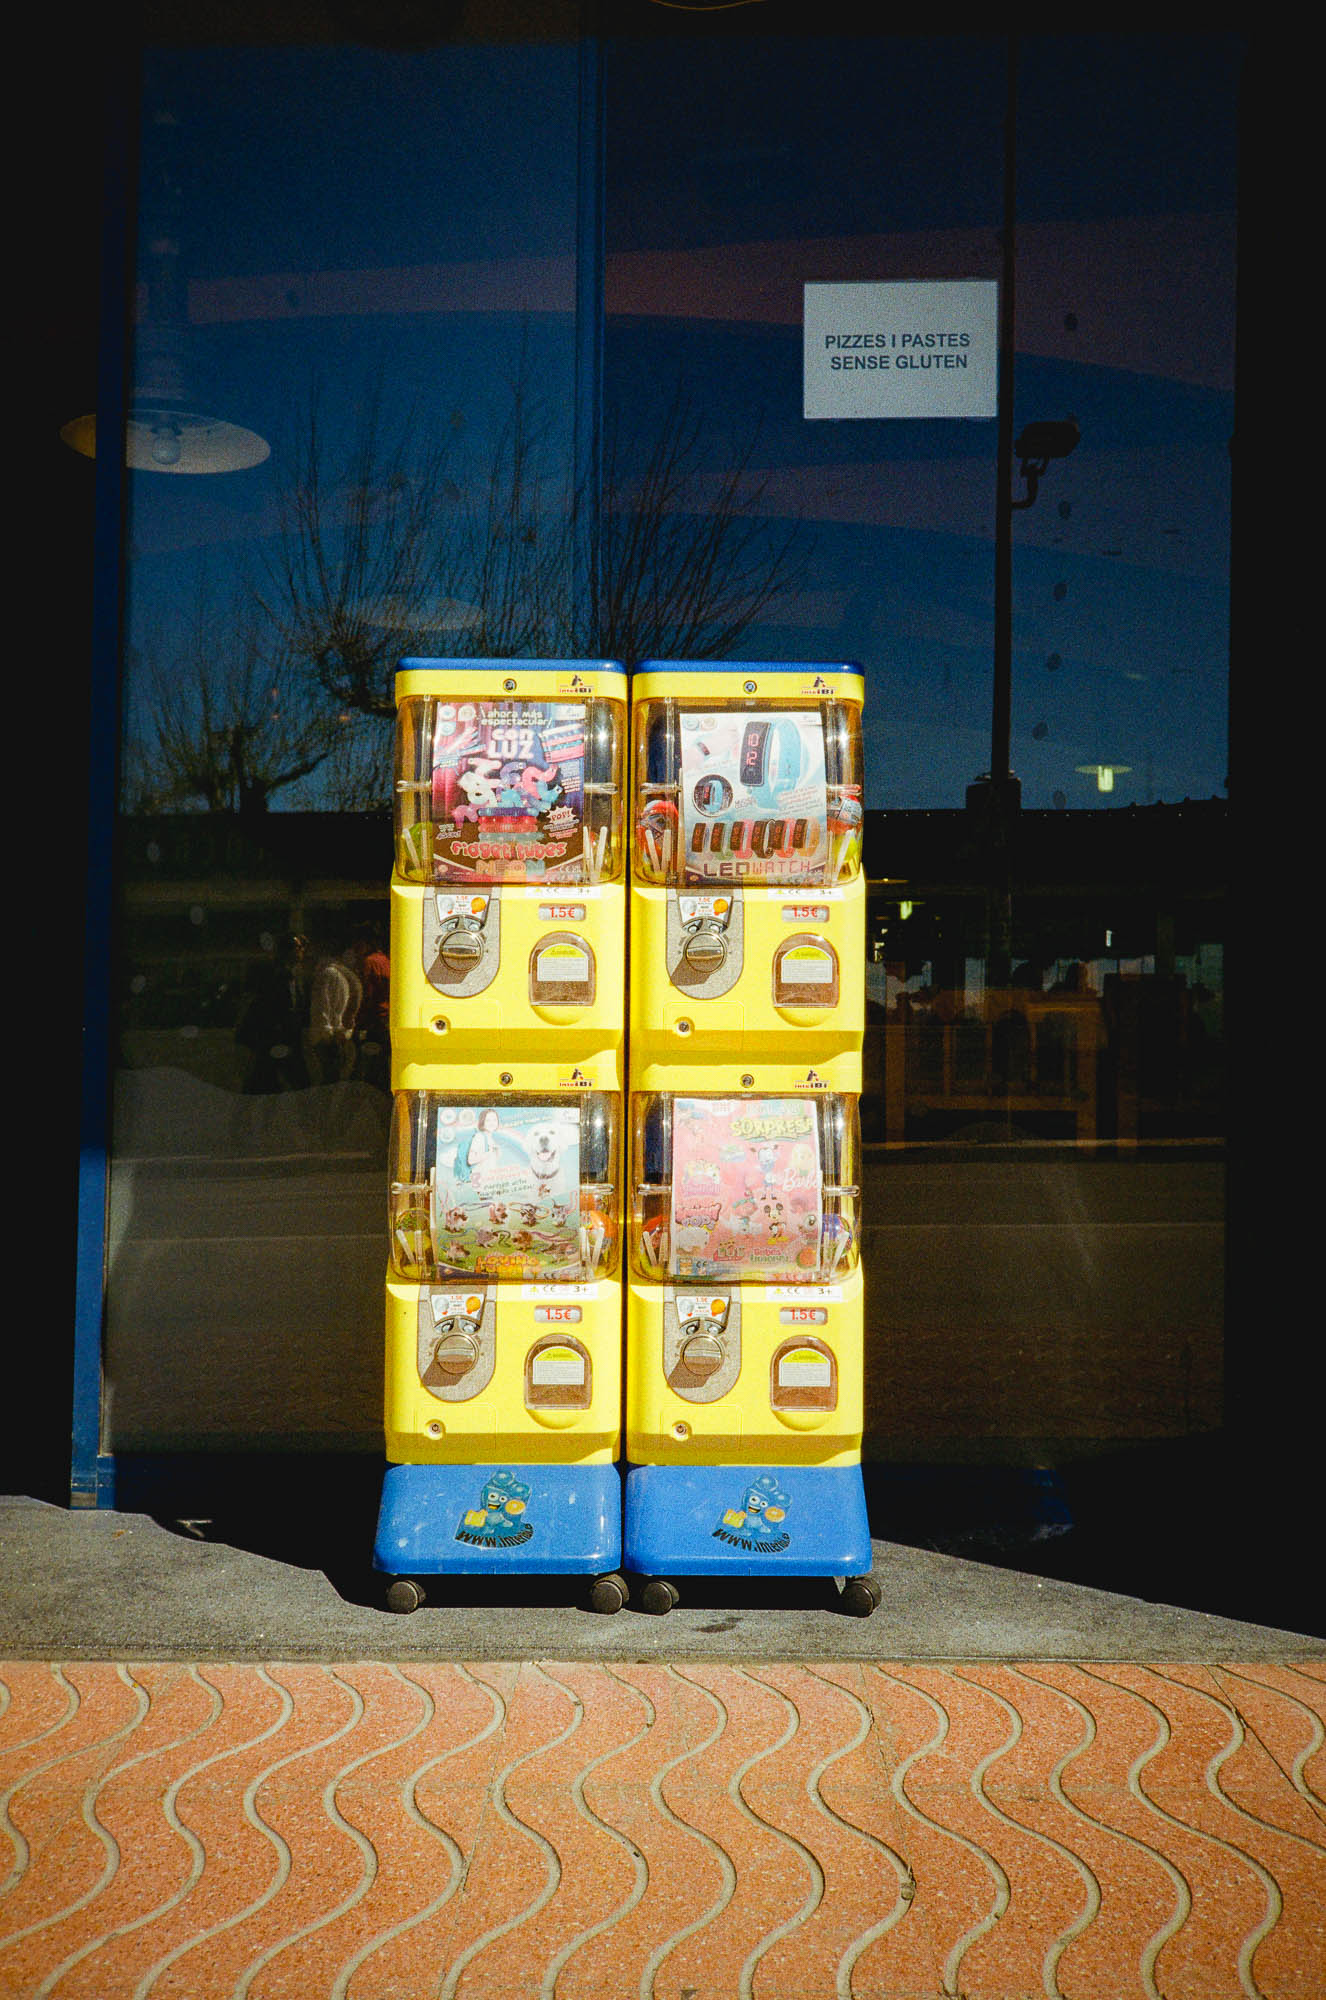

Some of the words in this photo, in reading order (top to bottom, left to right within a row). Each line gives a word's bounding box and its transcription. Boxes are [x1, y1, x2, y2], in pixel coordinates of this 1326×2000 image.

[825, 335, 886, 349] PIZZES
[891, 334, 896, 348] I
[902, 333, 971, 347] PASTES
[831, 356, 890, 370] SENSE
[896, 355, 968, 369] GLUTEN
[487, 708, 518, 718] ahora
[488, 740, 535, 760] LUZ
[476, 860, 545, 876] NEON
[549, 907, 575, 918] 1.5€
[792, 906, 818, 918] 1.5€
[545, 1308, 571, 1320] 1.5€
[790, 1308, 816, 1320] 1.5€
